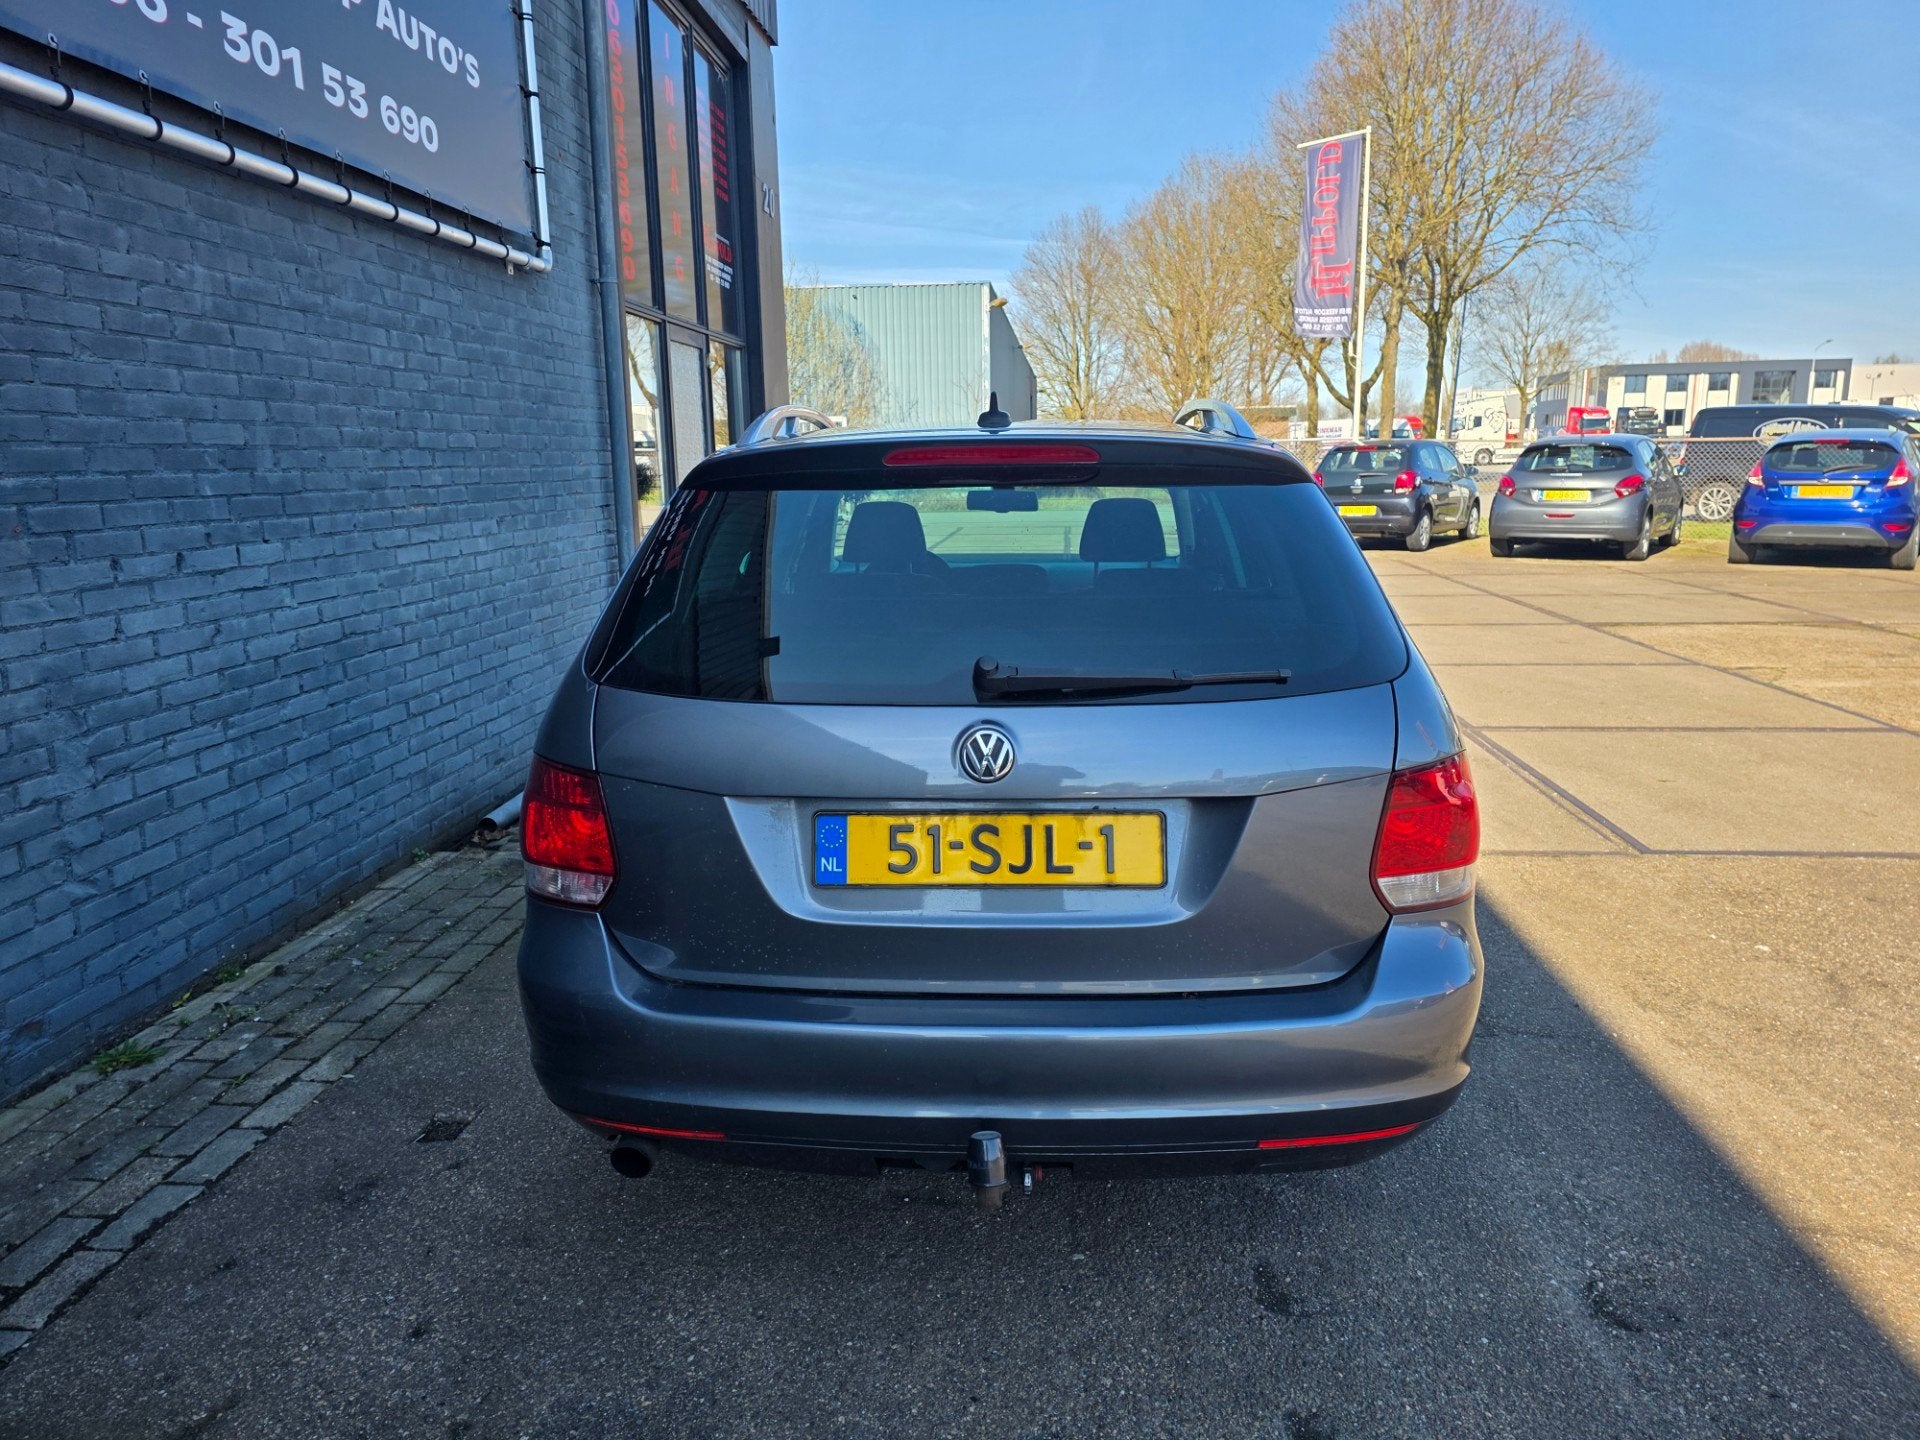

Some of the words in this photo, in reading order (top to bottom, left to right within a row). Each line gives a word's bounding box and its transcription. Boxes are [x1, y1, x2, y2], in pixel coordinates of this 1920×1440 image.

[376, 0, 480, 89] AUTO'S
[221, 10, 305, 91] 301
[321, 62, 369, 119] 53
[380, 95, 439, 153] 690
[762, 183, 775, 218] 20
[821, 857, 843, 873] NL
[888, 823, 1116, 875] 51-SJL-1
